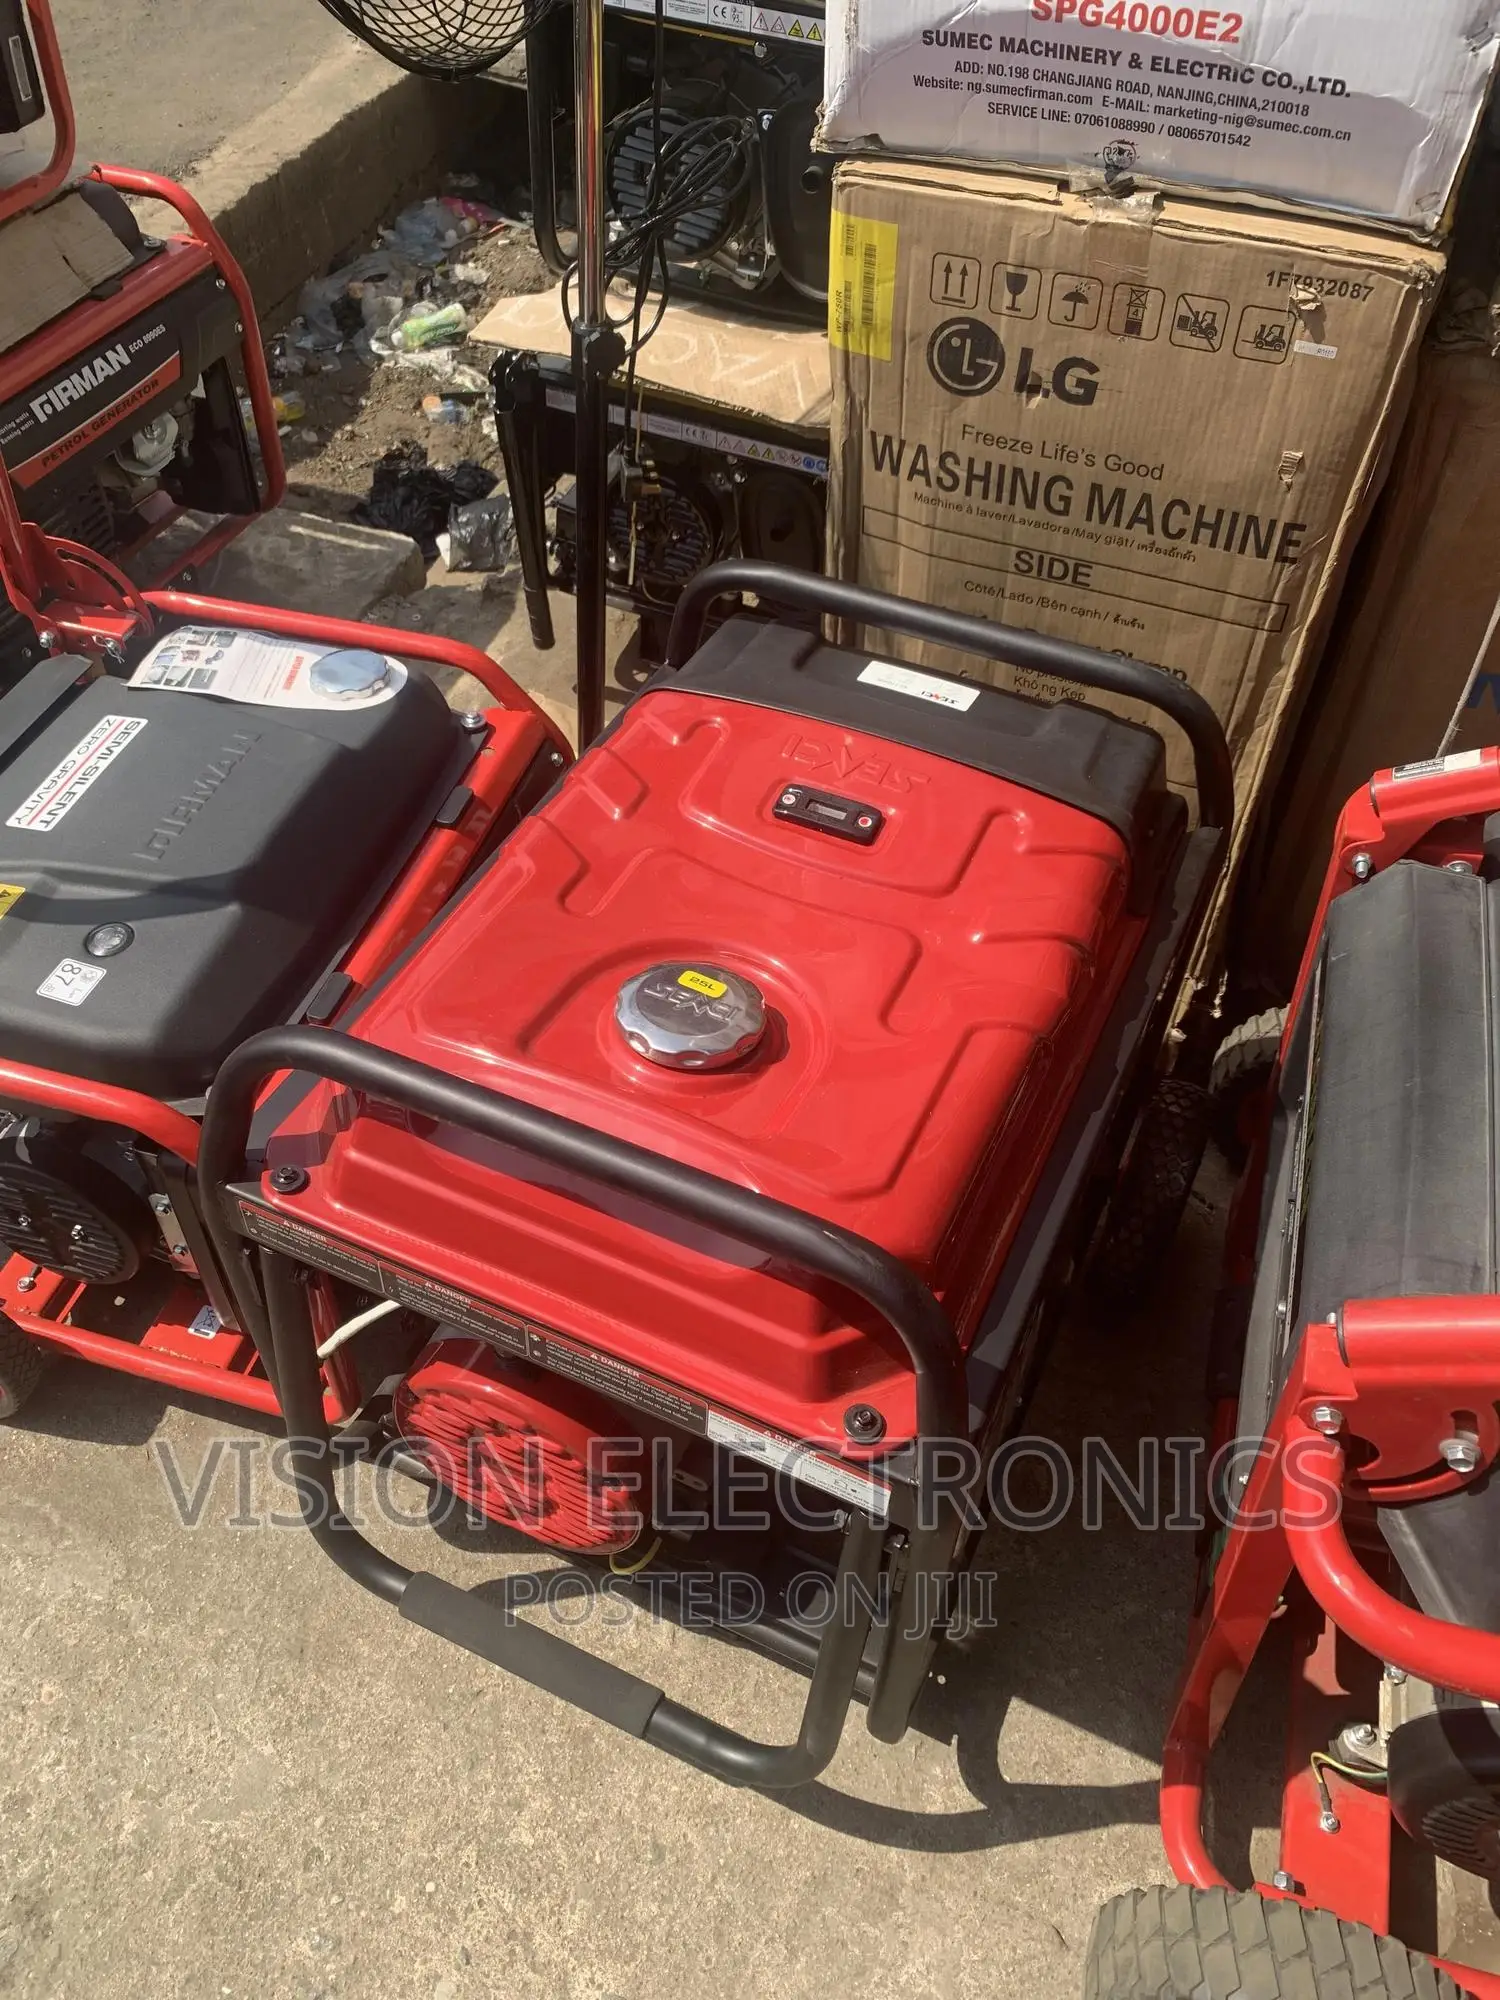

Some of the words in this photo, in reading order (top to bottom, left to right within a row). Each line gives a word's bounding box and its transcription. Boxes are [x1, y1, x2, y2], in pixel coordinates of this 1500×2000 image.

[1030, 0, 1243, 44] SPG4000E2
[922, 30, 993, 51] SUMEC
[999, 36, 1123, 67] MACHINERY
[1128, 52, 1143, 70] &
[1150, 55, 1255, 84] ELECTRIC
[1262, 70, 1351, 98] CO.,LTD.
[913, 74, 964, 91] Website:
[967, 83, 1093, 106] ng.sumecfirman.com
[1102, 94, 1150, 114] E-MAIL:
[1153, 103, 1352, 142] marketing-nig@sumec.com.cn
[954, 60, 984, 75] ADD:
[987, 63, 1030, 81] NO.198
[1032, 68, 1112, 91] CHANGJIANG
[1116, 80, 1153, 98] ROAD,
[1157, 84, 1310, 117] NANJING,CHINA,210018
[987, 102, 1038, 119] SERVICE
[1041, 107, 1071, 124] LINE:
[1074, 112, 1156, 135] 07061088990
[1167, 125, 1252, 148] 08065701542
[128, 338, 144, 353] ECO
[29, 343, 131, 423] FIRMAN
[1014, 346, 1101, 406] LG
[41, 431, 90, 468] PETROL
[91, 378, 160, 432] GENERATOR
[961, 423, 1034, 456] Freeze
[1039, 439, 1096, 467] Life's
[1104, 453, 1165, 481] Good
[870, 430, 1075, 517] WASHING
[1085, 482, 1307, 566] MACHINE
[914, 491, 963, 513] Machine
[1013, 550, 1094, 588] SIDE
[77, 718, 117, 756] ZERO
[15, 759, 77, 825] GRAVITY
[39, 720, 141, 829] SEMI-SILENT
[56, 963, 82, 987] 87
[688, 975, 717, 992] 25L
[290, 1221, 328, 1243] DANGER
[434, 1285, 472, 1305] DANGER
[601, 1357, 641, 1379] DANGER
[774, 1435, 817, 1457] DANGER
